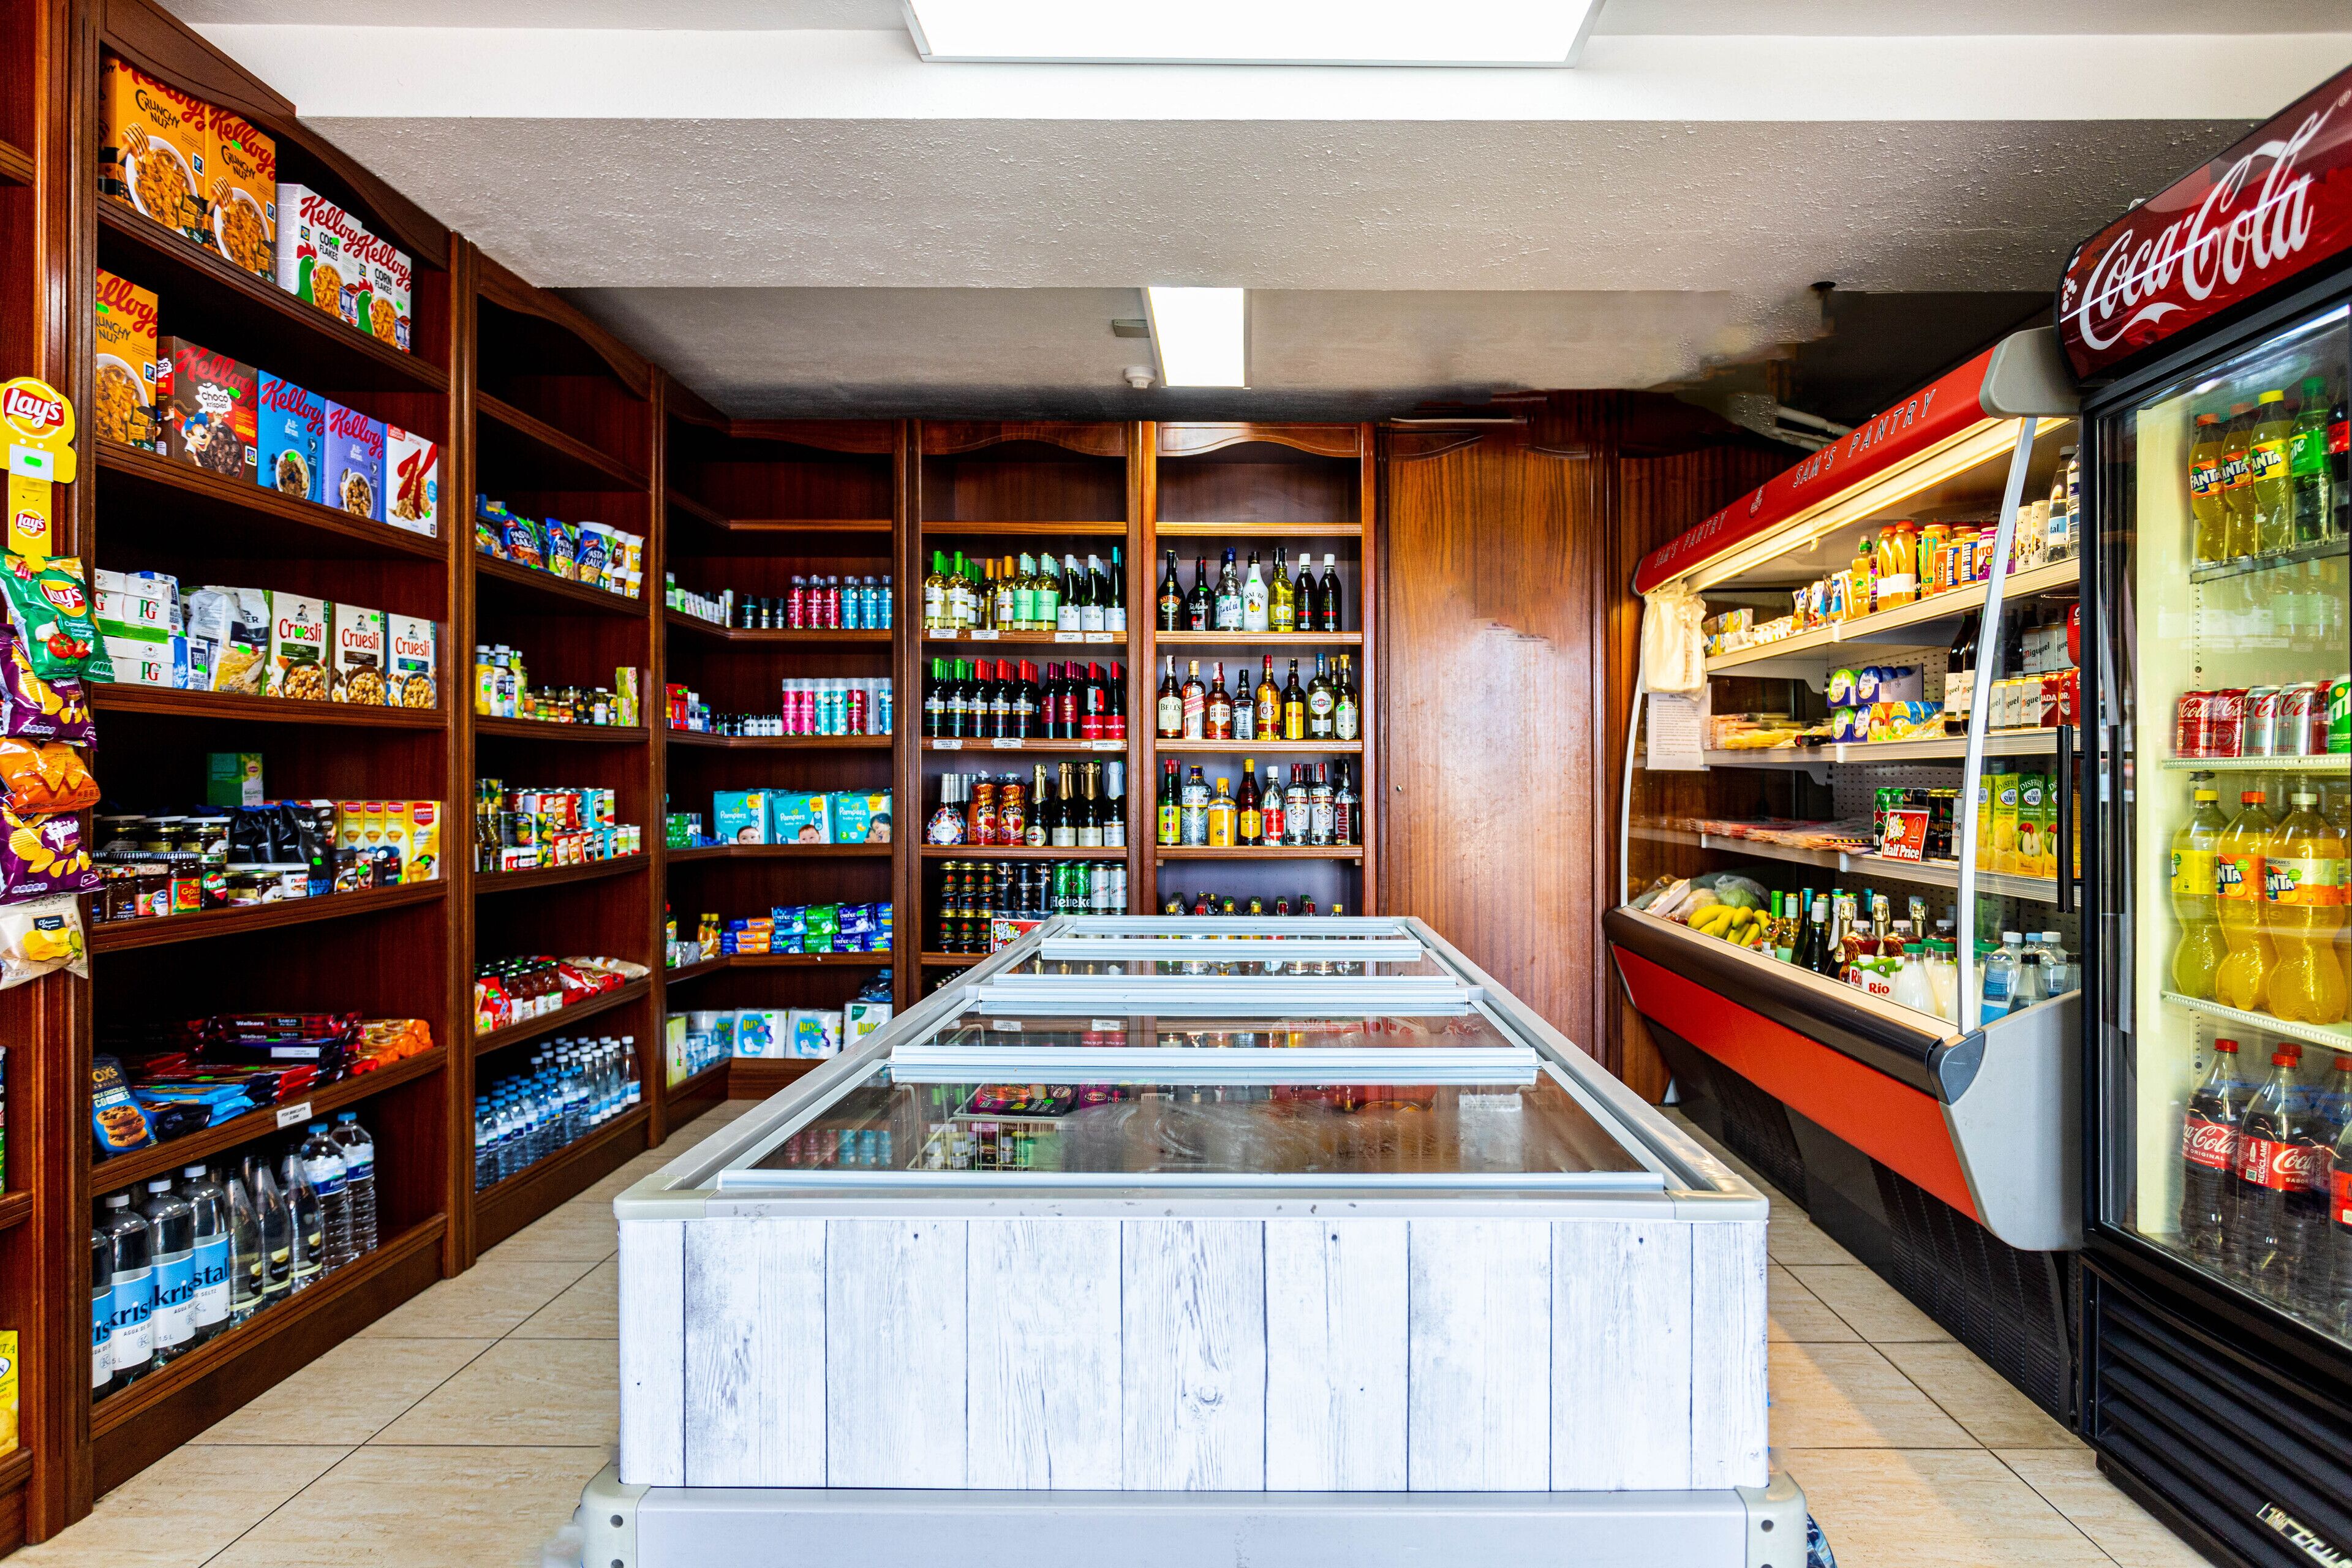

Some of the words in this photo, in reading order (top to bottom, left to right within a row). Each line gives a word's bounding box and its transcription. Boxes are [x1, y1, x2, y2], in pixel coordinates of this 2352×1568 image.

[135, 89, 180, 128] CRUNCHY
[150, 111, 172, 129] NUT
[221, 145, 255, 179] CRUNCHY
[232, 165, 248, 180] NUT
[2079, 112, 2328, 350] Coca-Cola
[319, 244, 339, 262] FLAKES
[374, 268, 392, 287] CORN
[374, 280, 392, 295] FLAKES
[96, 270, 157, 338] ellogg
[95, 315, 131, 341] RUNCHY
[98, 329, 119, 344] NUT
[6, 388, 62, 429] Lay's
[1793, 446, 1837, 489] SAM'S
[1847, 388, 1937, 458] PANTRY
[2252, 450, 2282, 472] ANTA
[397, 443, 439, 520] K
[17, 513, 45, 533] Lay's
[1654, 540, 1679, 569] SAM'S
[1682, 510, 1728, 552] PANTRY
[95, 592, 105, 611] G
[140, 599, 157, 620] PG
[279, 618, 322, 643] Cruesli
[342, 628, 379, 650] Cruesli
[395, 636, 429, 657] Cruesli
[141, 661, 159, 681] PG
[1259, 705, 1275, 715] 103
[720, 810, 746, 820] Pampers
[780, 812, 805, 821] Pampers
[839, 806, 867, 816] Pampers
[1883, 843, 1899, 858] Half
[1899, 845, 1920, 859] Price
[2217, 864, 2242, 883] NTA
[995, 922, 1010, 932] BIG
[997, 930, 1021, 941] DEALS
[2190, 1148, 2225, 1161] ORIGINAL
[193, 1258, 228, 1287] stal
[154, 1279, 194, 1307] kris
